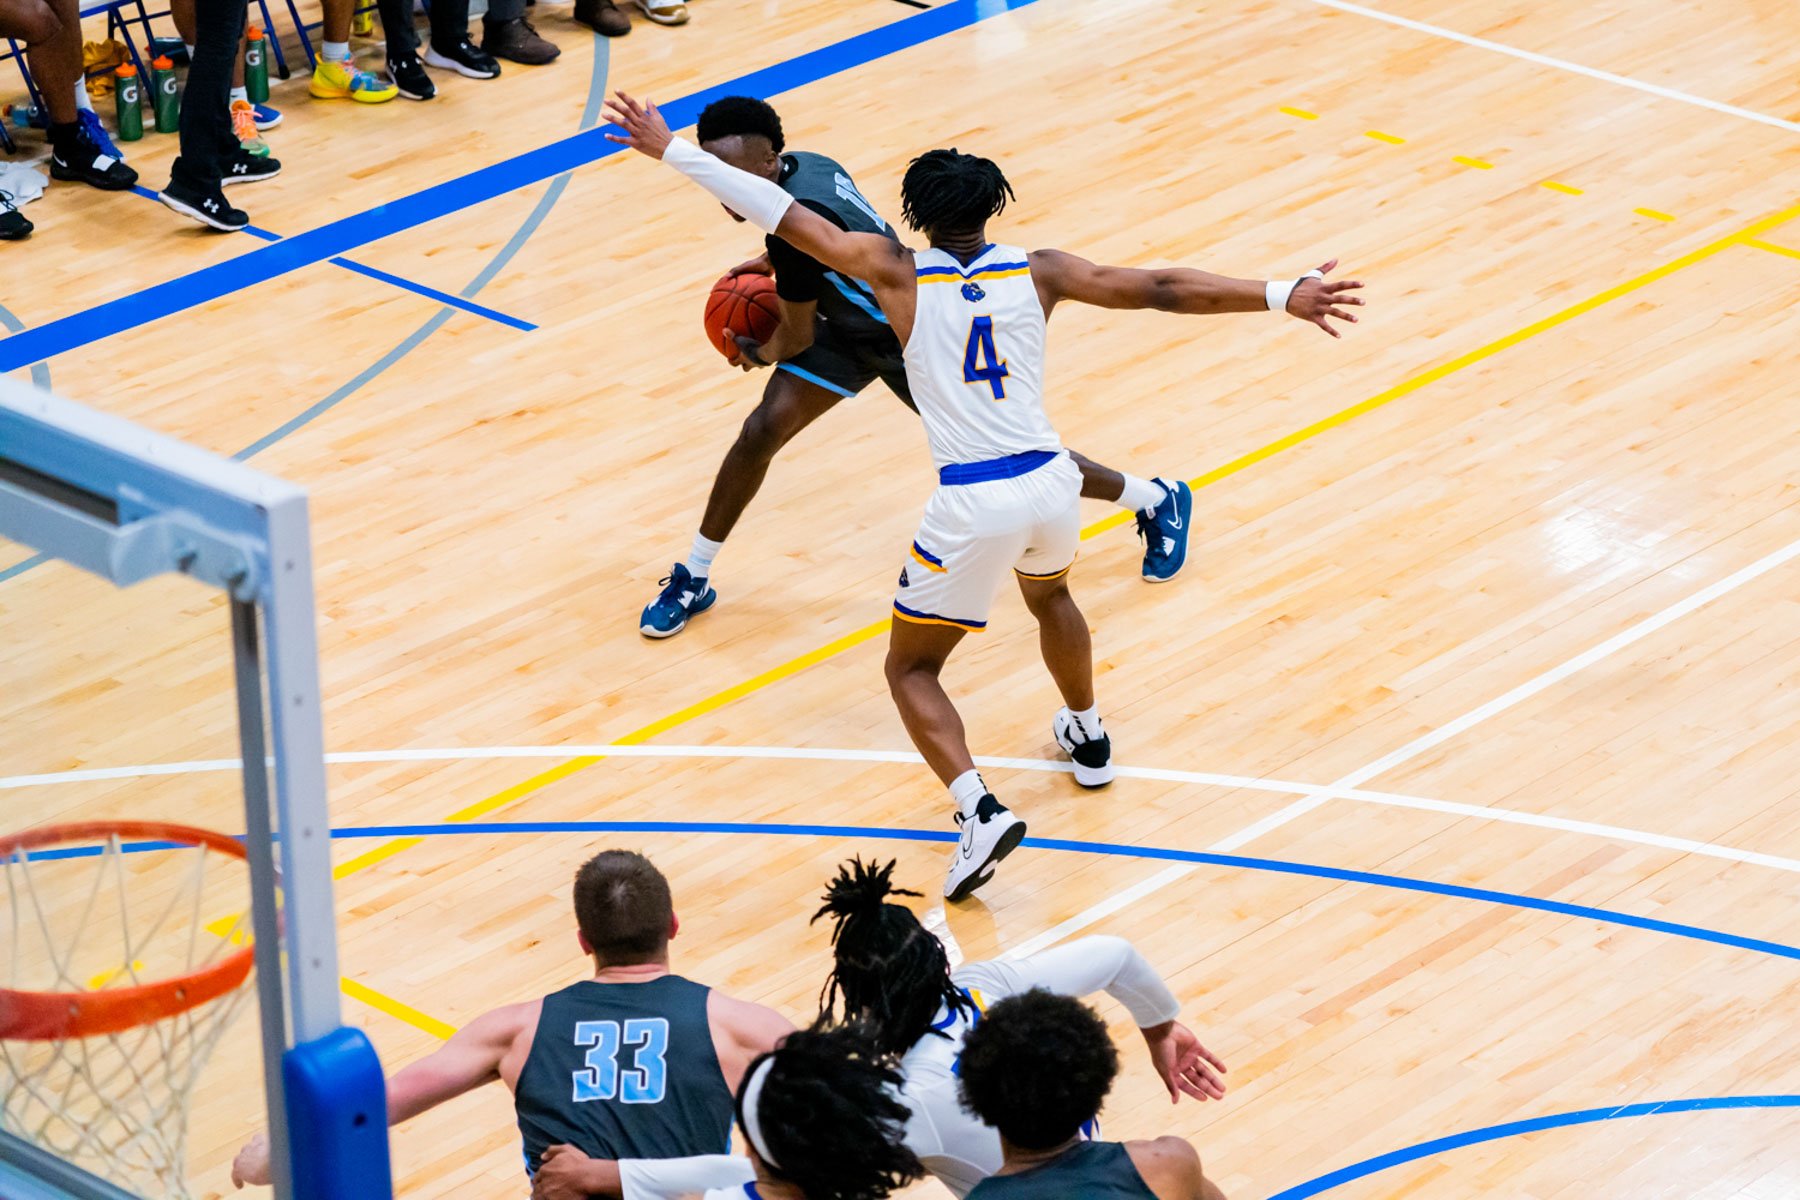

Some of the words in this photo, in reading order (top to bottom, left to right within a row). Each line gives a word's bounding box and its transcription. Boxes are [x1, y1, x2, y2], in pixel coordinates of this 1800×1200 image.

[245, 50, 261, 67] G
[122, 85, 138, 103] G
[163, 77, 177, 95] G
[962, 313, 1010, 402] 4
[572, 1017, 669, 1104] 33
